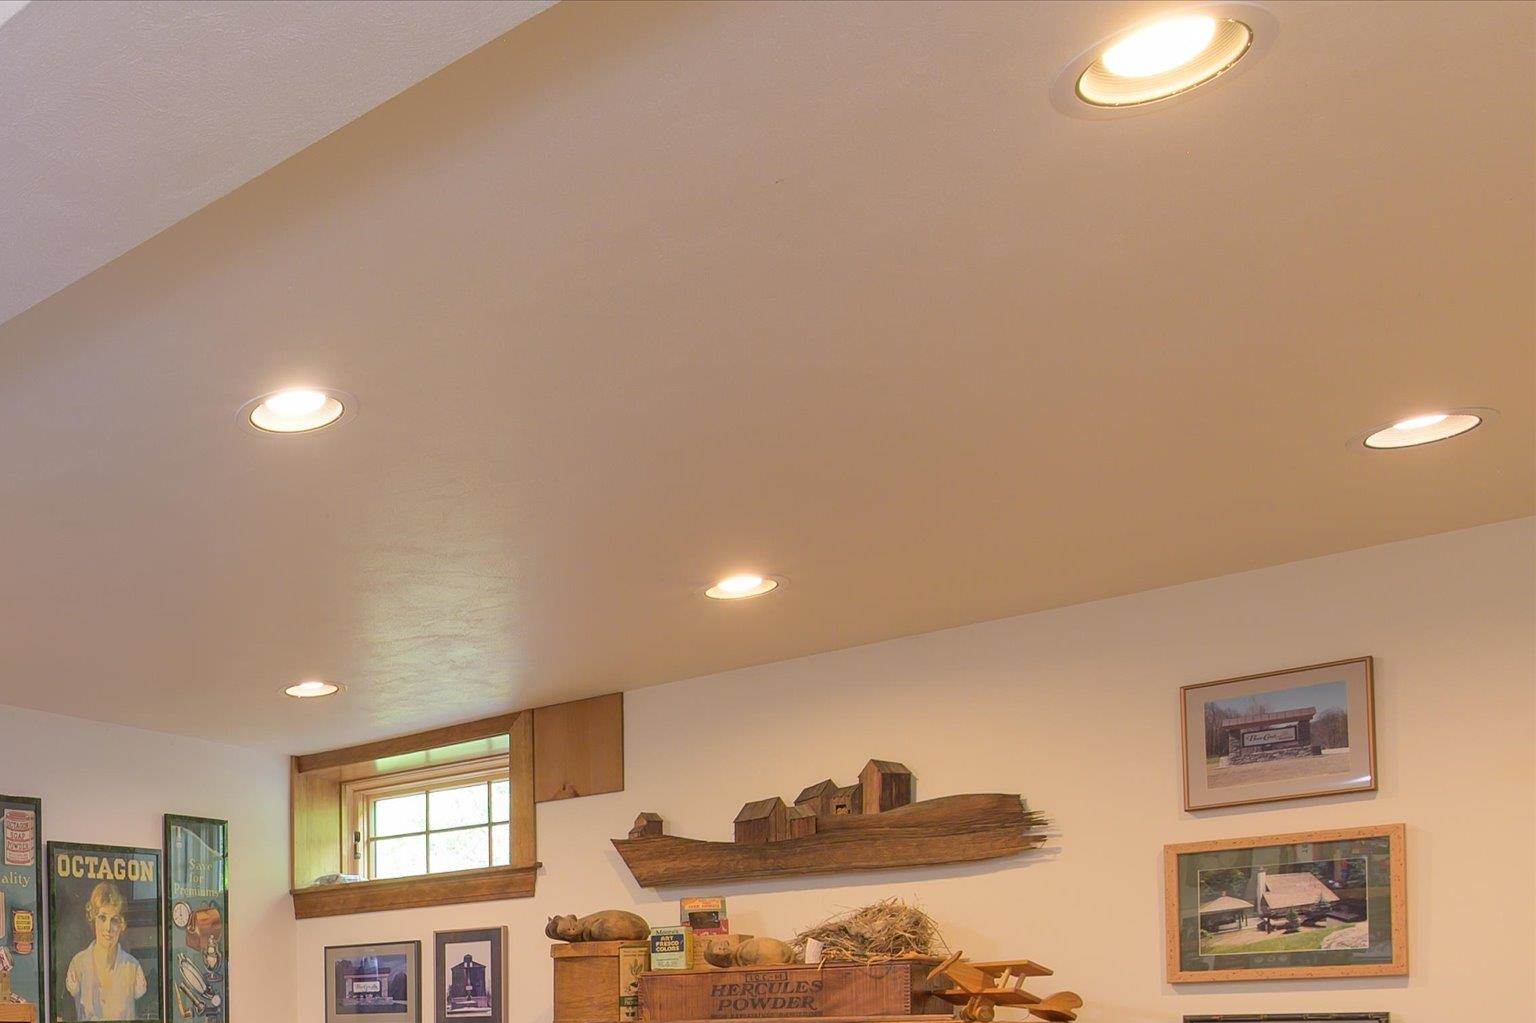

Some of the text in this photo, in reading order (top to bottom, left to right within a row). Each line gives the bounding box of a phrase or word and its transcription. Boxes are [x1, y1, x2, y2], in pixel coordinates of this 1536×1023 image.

[57, 854, 154, 882] OCTAGON
[710, 981, 824, 997] HERCULES
[718, 996, 817, 1011] POWDER
